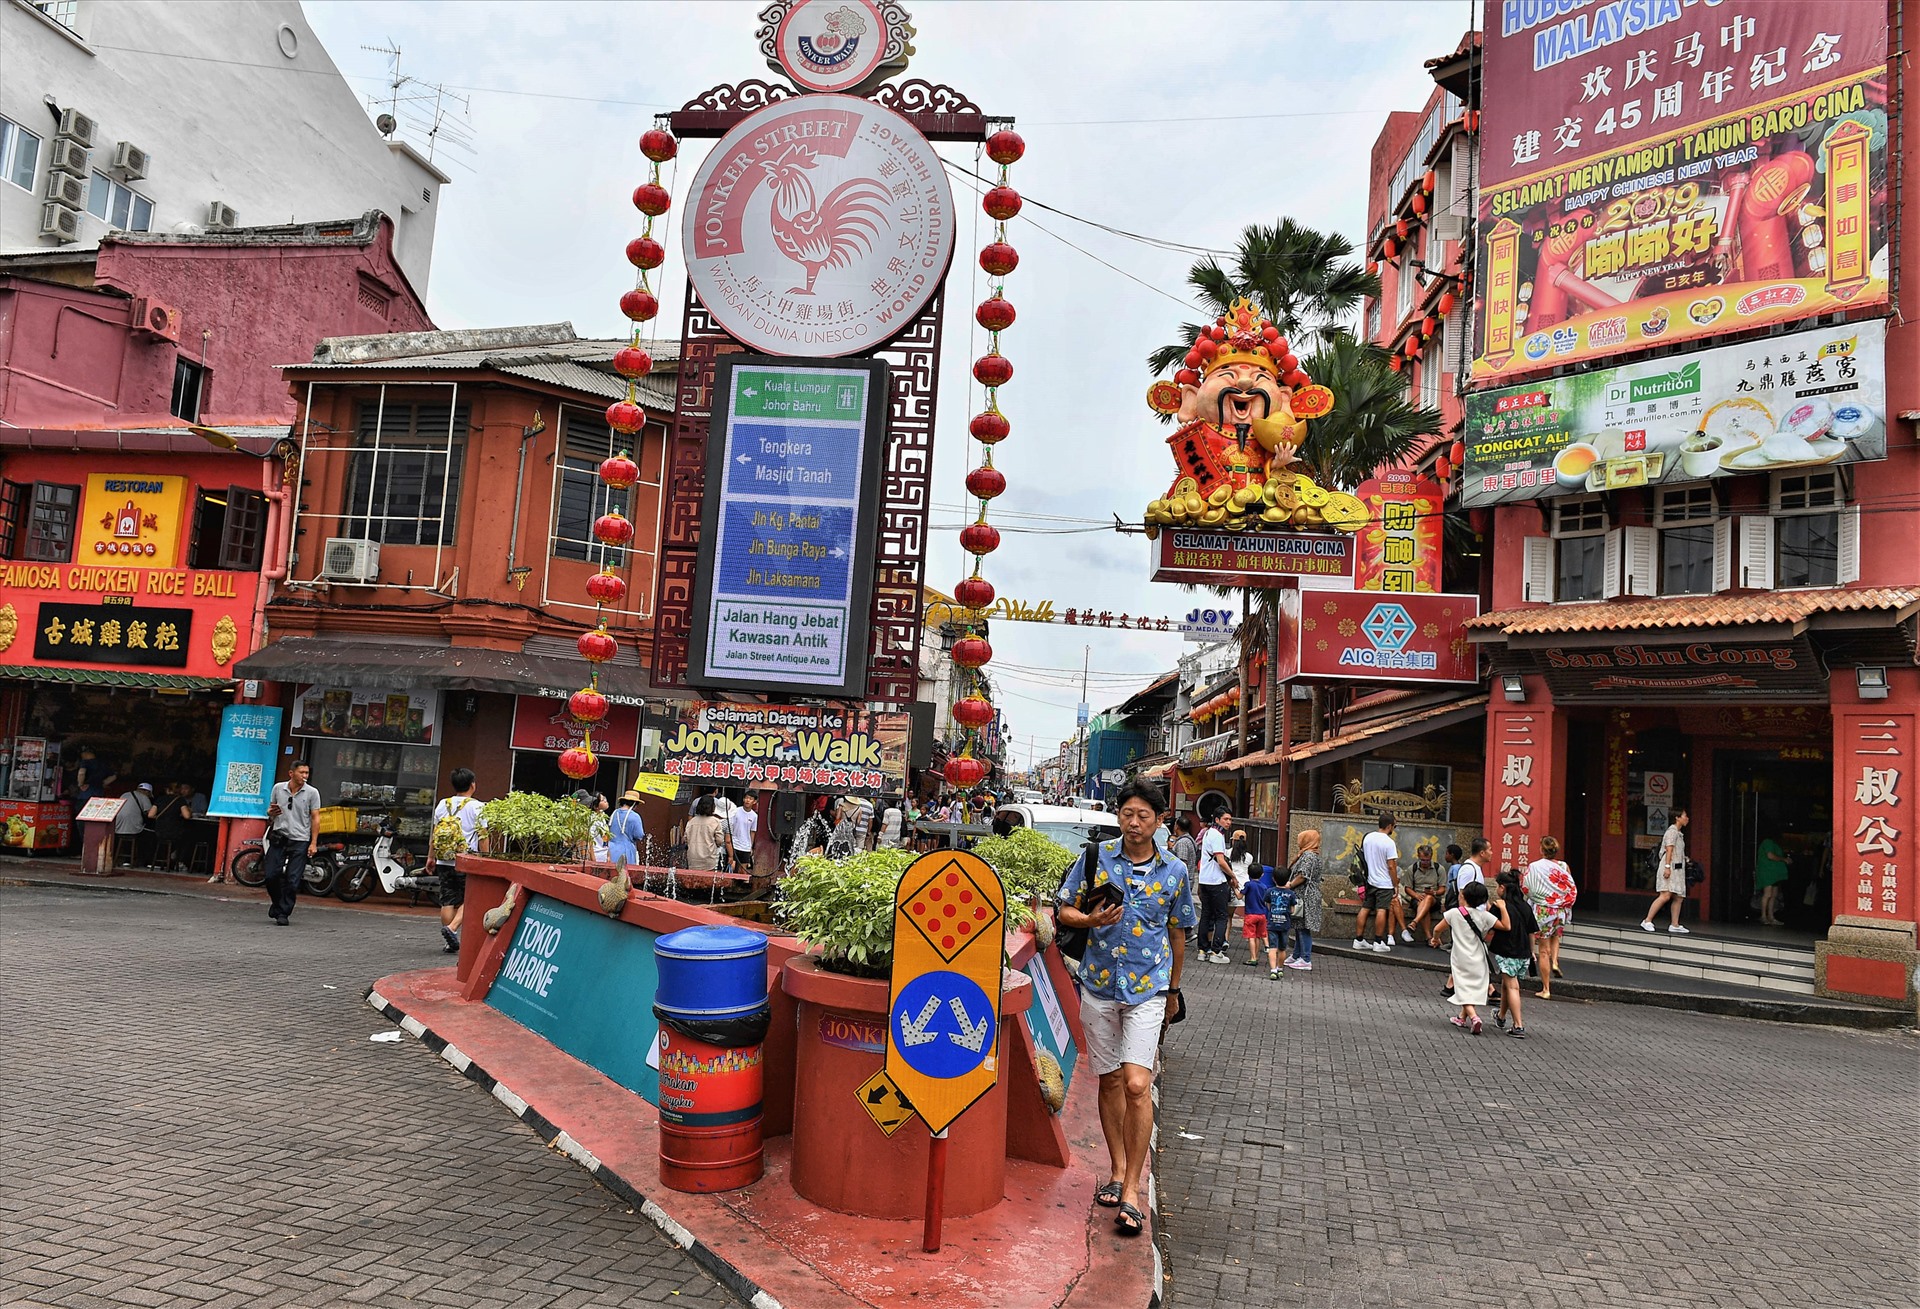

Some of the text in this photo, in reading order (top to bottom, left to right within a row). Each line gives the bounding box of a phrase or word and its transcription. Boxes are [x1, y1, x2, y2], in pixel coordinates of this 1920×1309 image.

[1535, 0, 1679, 69] MALAYSIA
[801, 41, 855, 64] JONKER WALK
[1580, 14, 1756, 103] 欢庆马中
[1510, 32, 1842, 167] 建交45周年纪念
[1492, 84, 1866, 216] SELAMAT MENYAMBUT TAHUN BARU CINA
[704, 120, 848, 248] JONKER STREET
[1565, 145, 1759, 211] HAPPY CHINESE NEW YEAR
[1602, 181, 1700, 231] 2019
[1836, 149, 1858, 270] 万事如意
[870, 122, 942, 324] WORLD CULTURAL HERITAGE
[1583, 207, 1718, 281] 嘟嘟好
[1614, 260, 1686, 283] HAPPY NEW YEAR
[1665, 271, 1704, 288] 己亥年
[709, 262, 868, 343] WARISAN DUNIA UNESCO
[1492, 242, 1512, 342] 新年快乐
[1553, 328, 1578, 340] G.L.
[1589, 324, 1626, 341] MELAKA
[1590, 318, 1618, 333] TRUE
[764, 380, 832, 394] Kuala Lumpur
[1611, 379, 1692, 400] Dr Nutrition
[762, 399, 821, 412] Johor Bahru
[1605, 408, 1703, 428] www.drnutrition.com.my
[760, 438, 812, 458] Tengkera
[1474, 436, 1542, 455] TONGKAT
[1545, 432, 1569, 444] ALI
[756, 465, 832, 484] Masjid Tanah
[1387, 474, 1410, 482] 2019
[1483, 467, 1557, 492] 東革阿里
[104, 480, 164, 494] RESTORAN
[1380, 482, 1417, 494] 己亥年
[752, 511, 821, 531] Jln Kg. Pantai
[749, 540, 827, 561] Jln Bunga Raya
[1173, 533, 1346, 556] SELAMAT TAHUN BARU CINA
[1384, 502, 1416, 592] 财神到
[68, 567, 140, 593] CHICKEN
[147, 572, 186, 595] RICE
[193, 573, 237, 598] BALL
[746, 568, 821, 588] Jln Laksamana
[723, 609, 839, 628] Jalan Hang Jebat
[996, 596, 1056, 622] Walk
[1186, 608, 1234, 626] JOY
[44, 616, 180, 650] 古城雞飯粒
[730, 629, 828, 648] Kawasan Antik
[726, 650, 830, 665] Jalan Street Antique Area
[1546, 643, 1798, 671] San Shu Gong
[538, 687, 568, 699] 茶の道
[1612, 676, 1637, 685] House
[1649, 679, 1686, 687] Authentic
[604, 694, 644, 706] CHADO
[228, 713, 275, 726] 本店推荐
[706, 707, 844, 729] Selamat Datang Ke
[232, 726, 268, 740] 支付宝
[666, 722, 883, 766] Jonker Walk
[664, 759, 882, 789] 欢迎来到马六甲鸡场街文化坊
[1500, 716, 1534, 827] 三叔公
[1854, 720, 1900, 854] 三叔公
[1370, 796, 1414, 806] Malacca
[1858, 861, 1874, 912] 食品廠
[1882, 863, 1898, 914] 有限公司
[518, 917, 562, 958] TOKIO
[502, 948, 560, 998] MARINE
